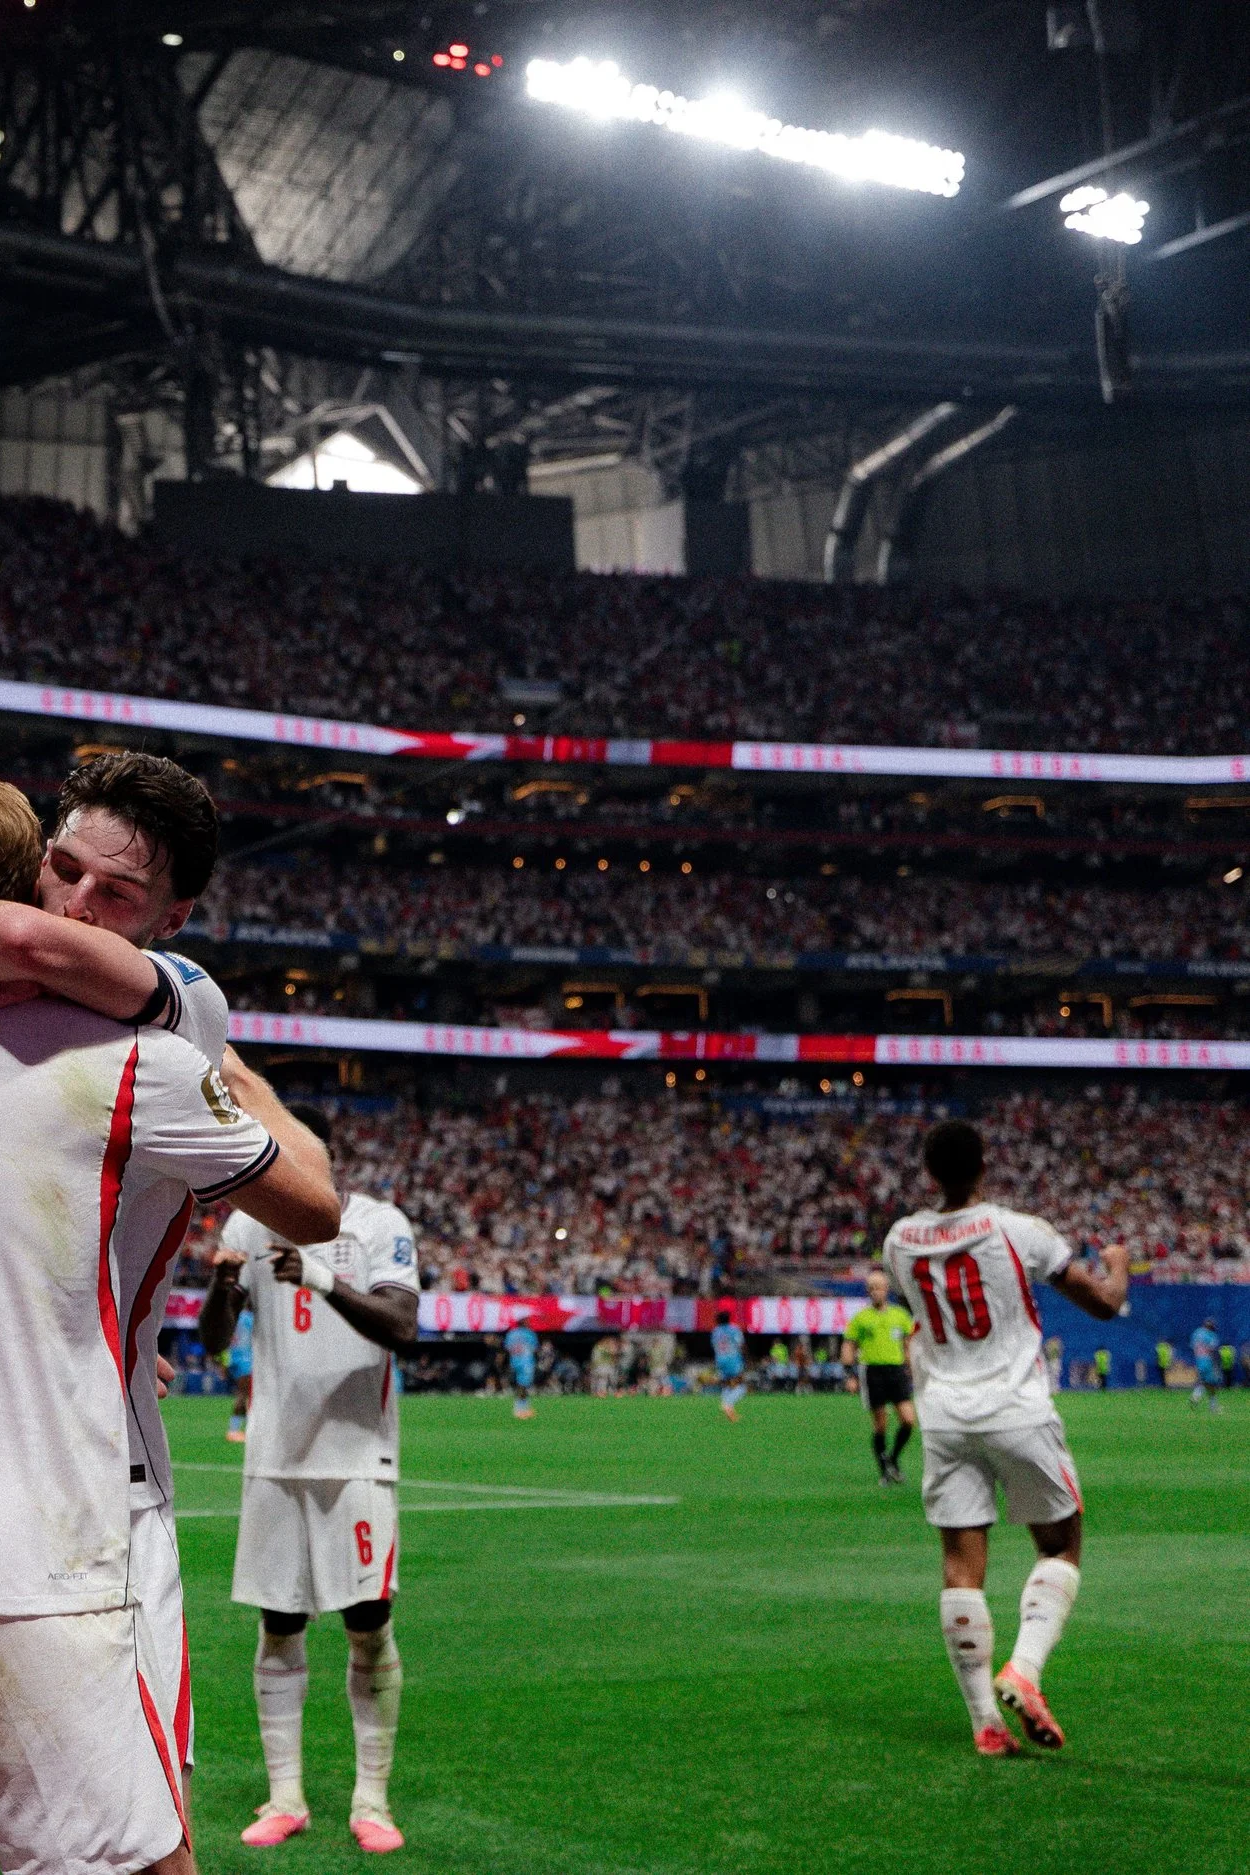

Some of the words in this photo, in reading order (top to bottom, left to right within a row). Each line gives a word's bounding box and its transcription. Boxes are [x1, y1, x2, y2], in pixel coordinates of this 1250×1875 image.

[293, 1286, 313, 1334] 6
[912, 1251, 993, 1344] 10
[354, 1520, 373, 1567] 6
